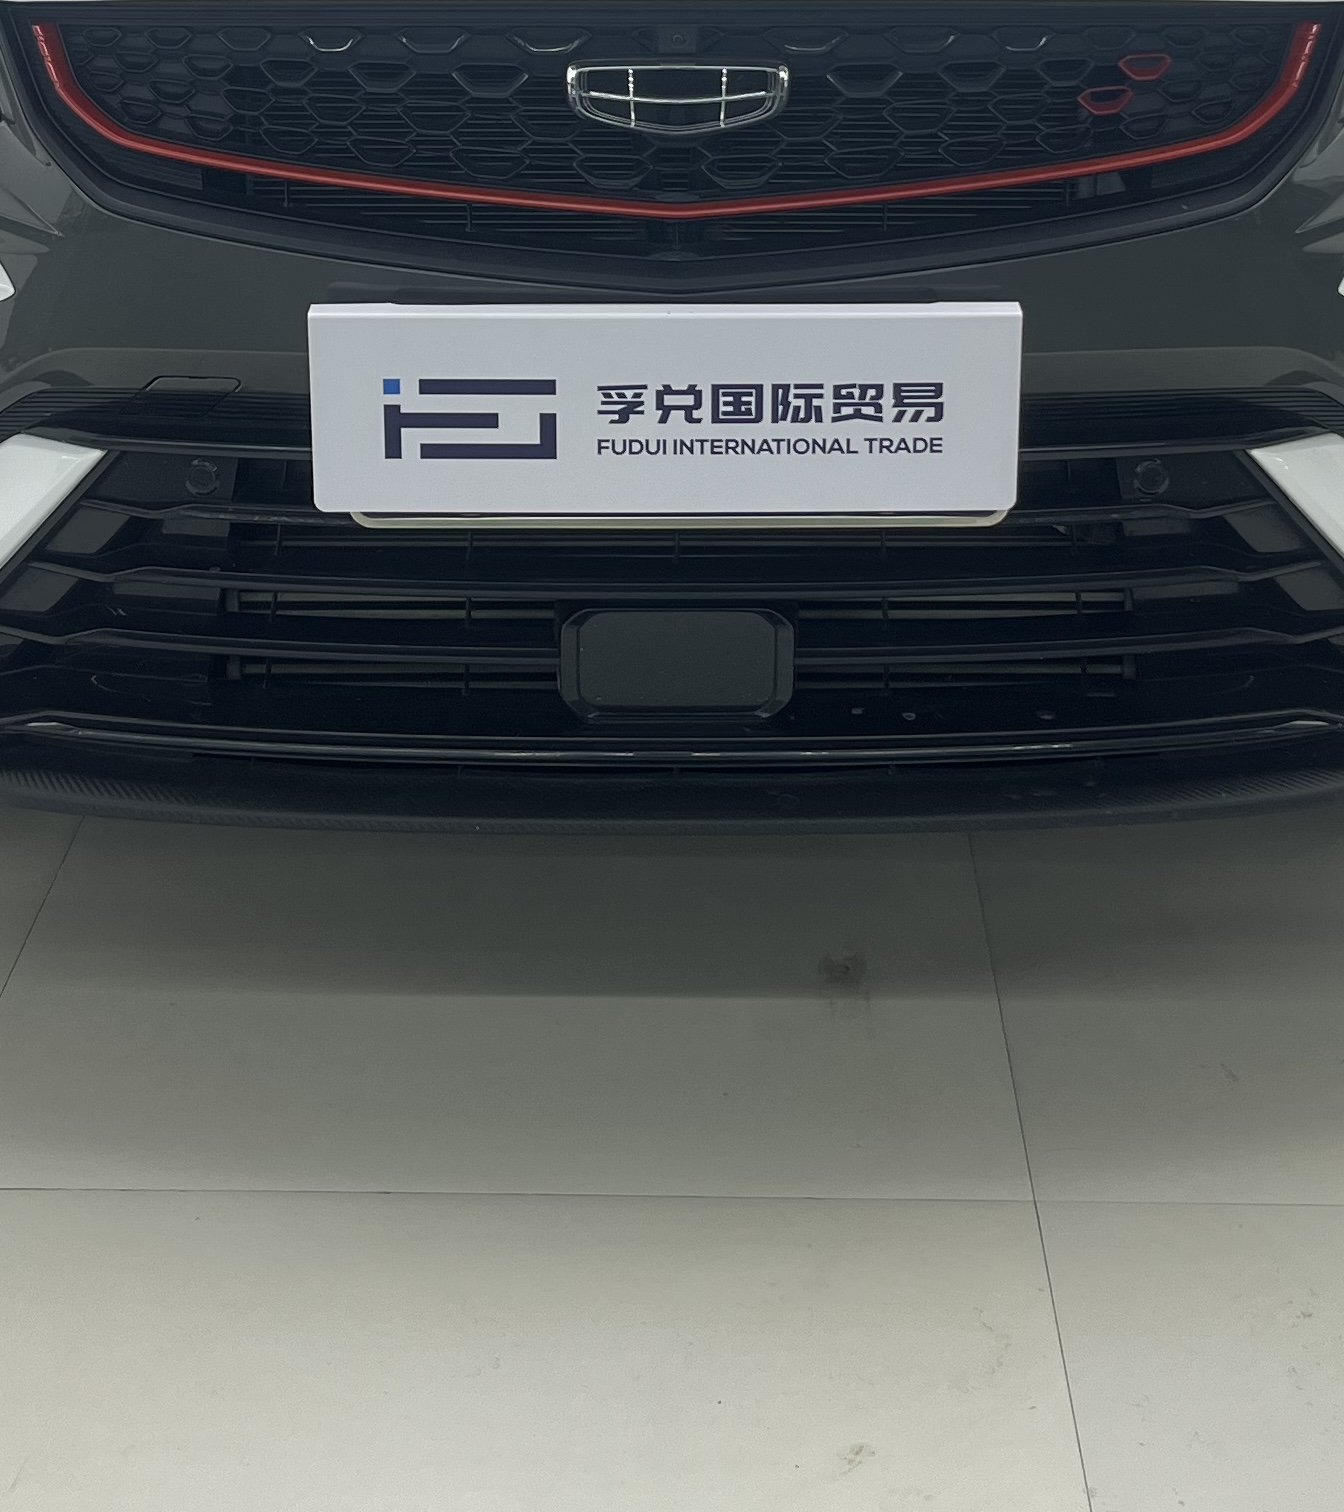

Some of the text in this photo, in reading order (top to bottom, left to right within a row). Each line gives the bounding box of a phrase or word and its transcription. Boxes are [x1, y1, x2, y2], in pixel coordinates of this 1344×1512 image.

[596, 382, 945, 425] 孚兑国际贸易
[597, 436, 944, 456] FUDUI INTERNATIONAL TRADE
